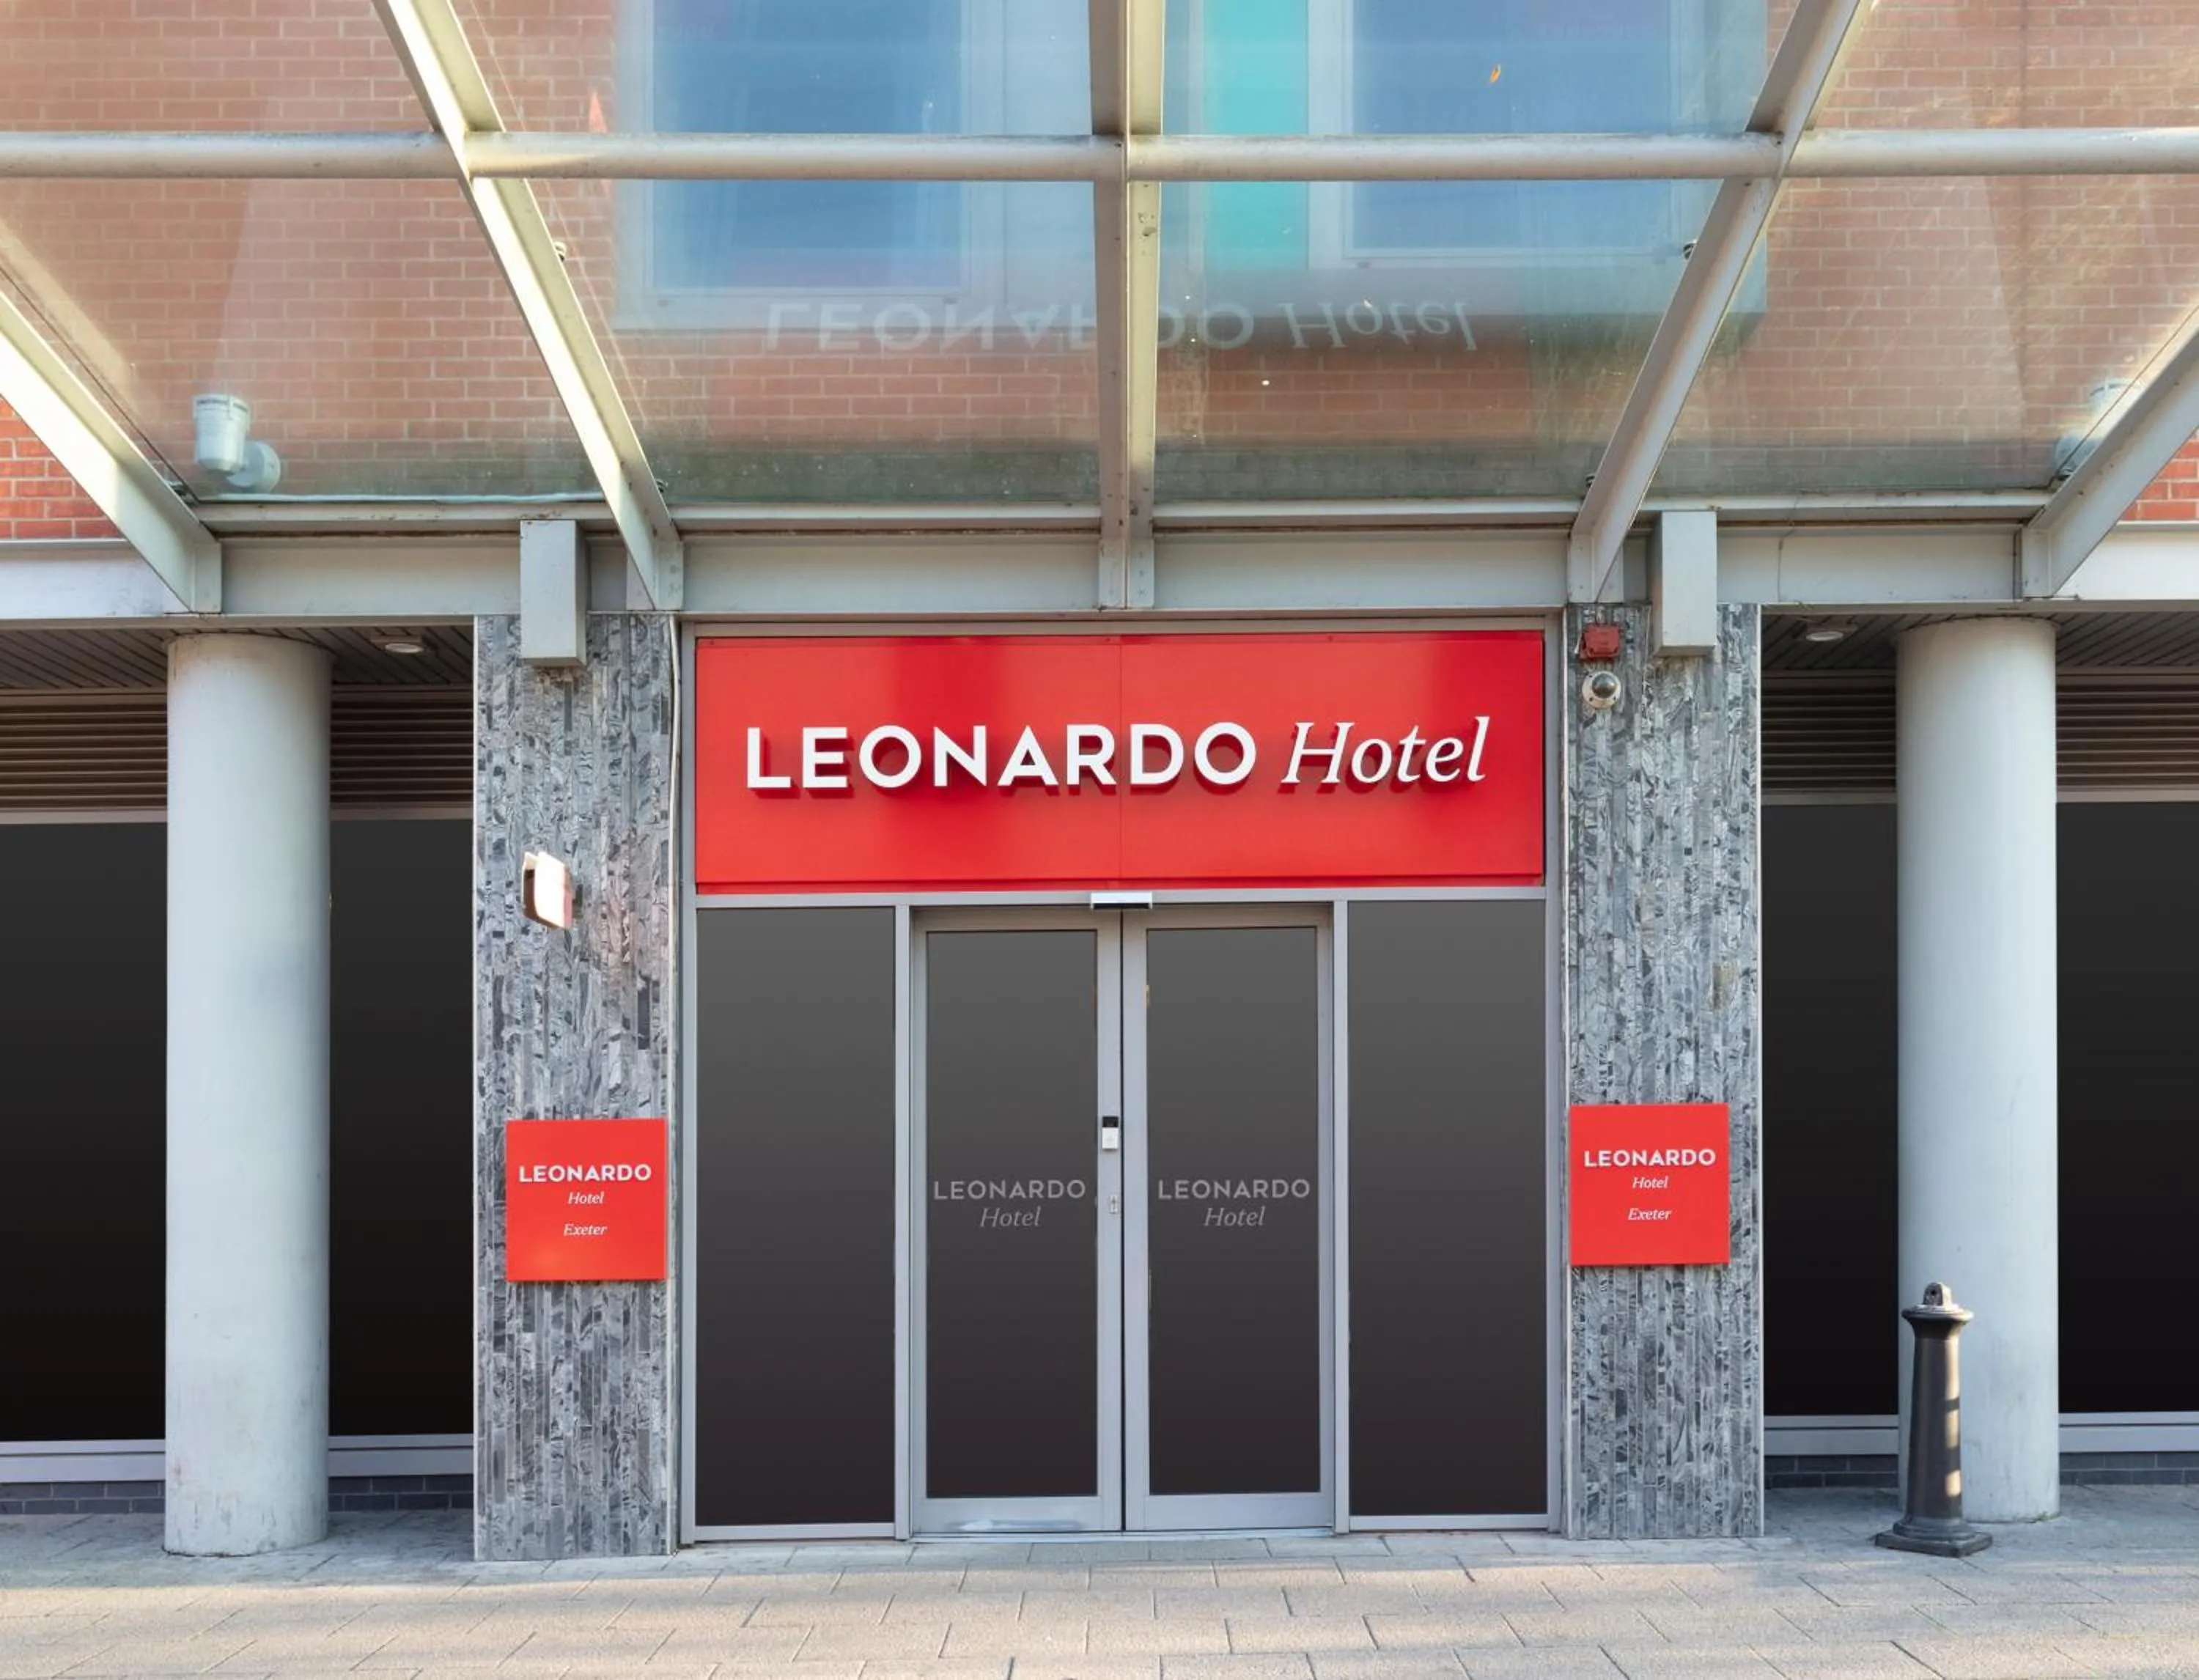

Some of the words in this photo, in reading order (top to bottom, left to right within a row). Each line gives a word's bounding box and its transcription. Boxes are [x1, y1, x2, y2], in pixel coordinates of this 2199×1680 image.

[747, 722, 1257, 788] LEONARDO
[1281, 716, 1490, 783] Hotel
[1584, 1149, 1716, 1167] LEONARDO
[518, 1163, 652, 1182] LEONARDO
[1632, 1176, 1668, 1188] Hotel
[567, 1191, 605, 1204] Hotel
[933, 1179, 1086, 1200] LEONARDO
[1158, 1179, 1311, 1199] LEONARDO
[979, 1206, 1042, 1227] Hotel
[1204, 1206, 1266, 1227] Hotel
[1627, 1208, 1672, 1220] Exeter
[563, 1223, 608, 1236] Exeter
